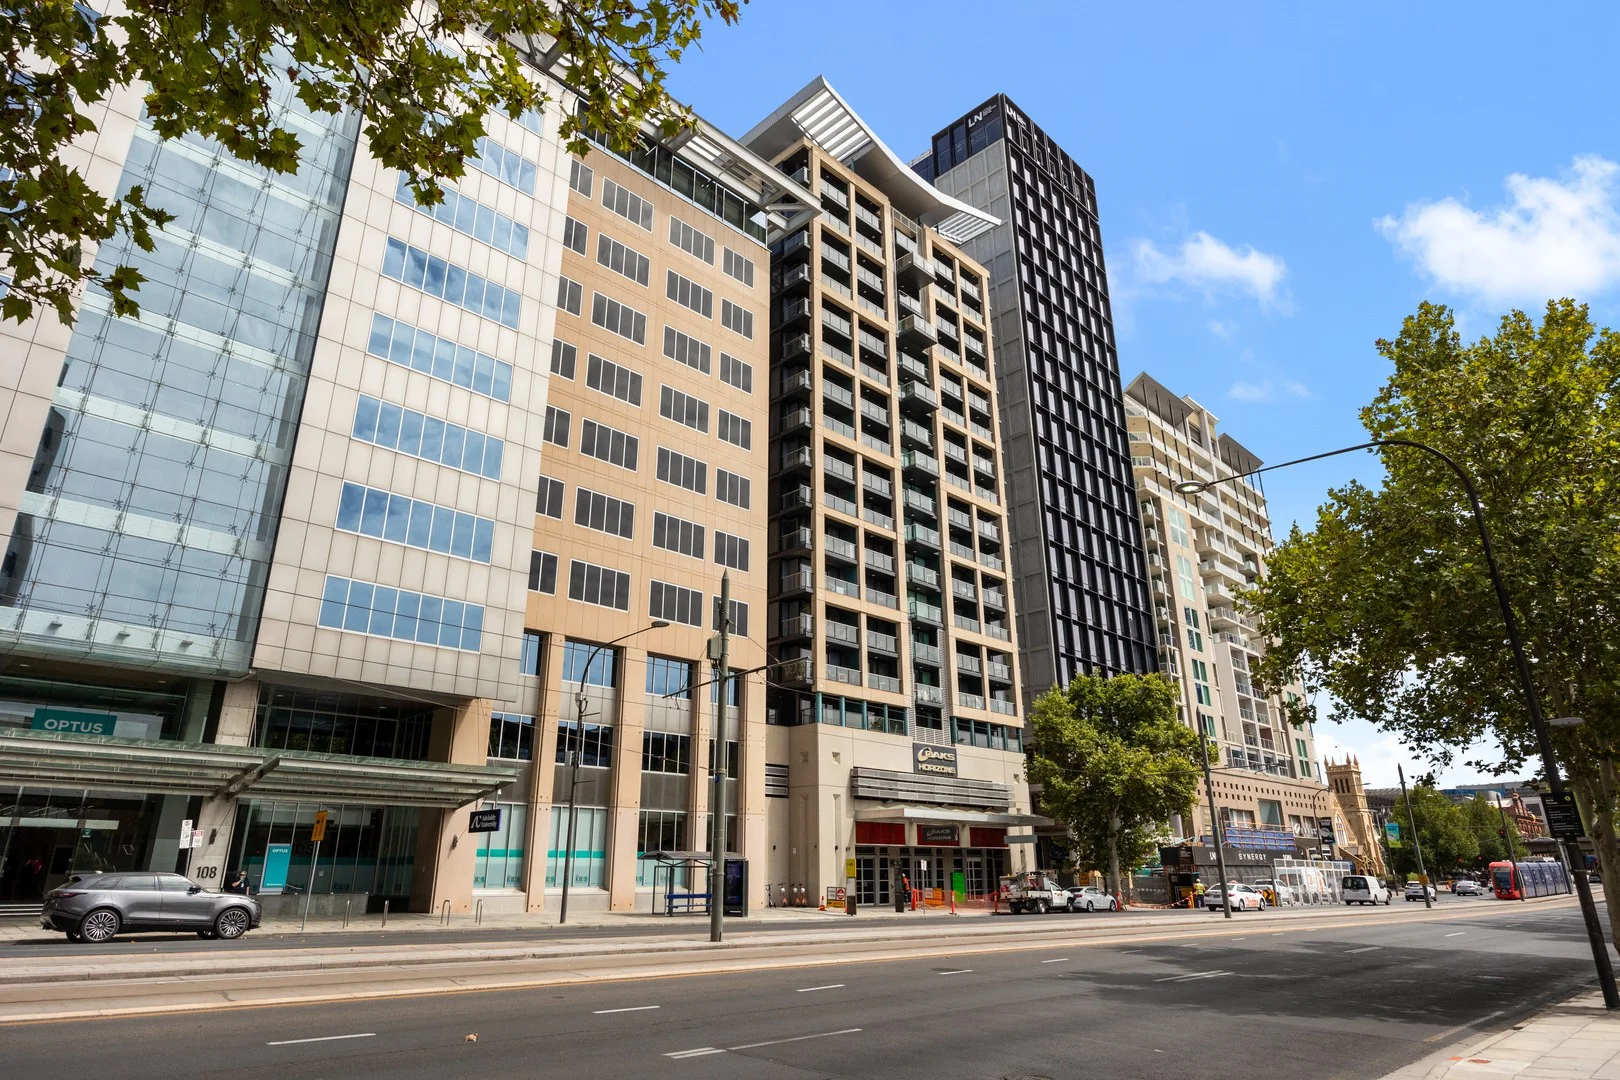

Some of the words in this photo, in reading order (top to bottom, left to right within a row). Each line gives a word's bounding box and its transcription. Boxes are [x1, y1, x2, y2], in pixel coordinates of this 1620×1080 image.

[968, 111, 983, 128] LN
[44, 719, 103, 734] OPTUS
[919, 748, 956, 761] OAKS
[918, 763, 956, 774] HORIZONS
[1238, 853, 1266, 861] SYNERGY
[196, 866, 217, 879] 108
